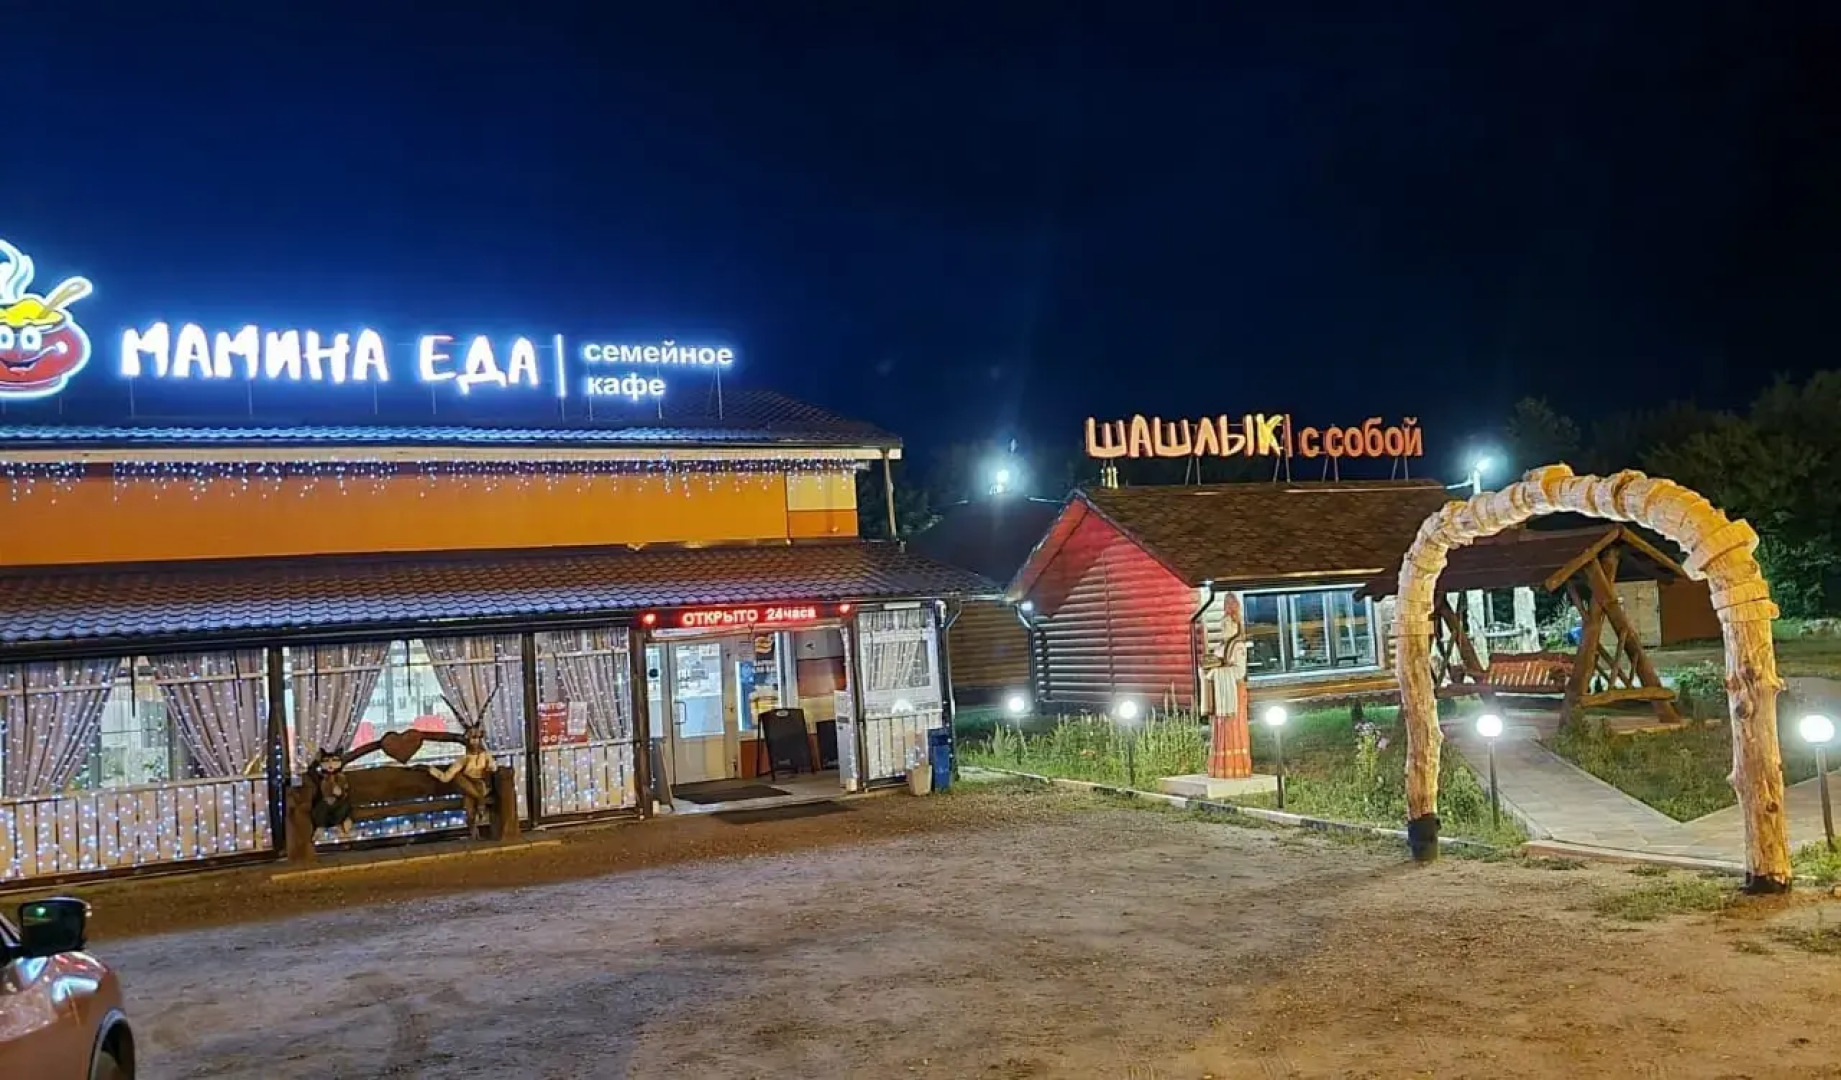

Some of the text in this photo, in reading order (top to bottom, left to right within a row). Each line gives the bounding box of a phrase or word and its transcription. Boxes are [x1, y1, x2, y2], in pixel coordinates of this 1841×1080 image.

[121, 322, 538, 394] МАМИНА ЕДА
[584, 341, 734, 366] семейное
[587, 373, 665, 400] кафе
[1086, 414, 1423, 458] ШАШЛЫК с собой
[682, 612, 758, 625] ОТКРЫТО
